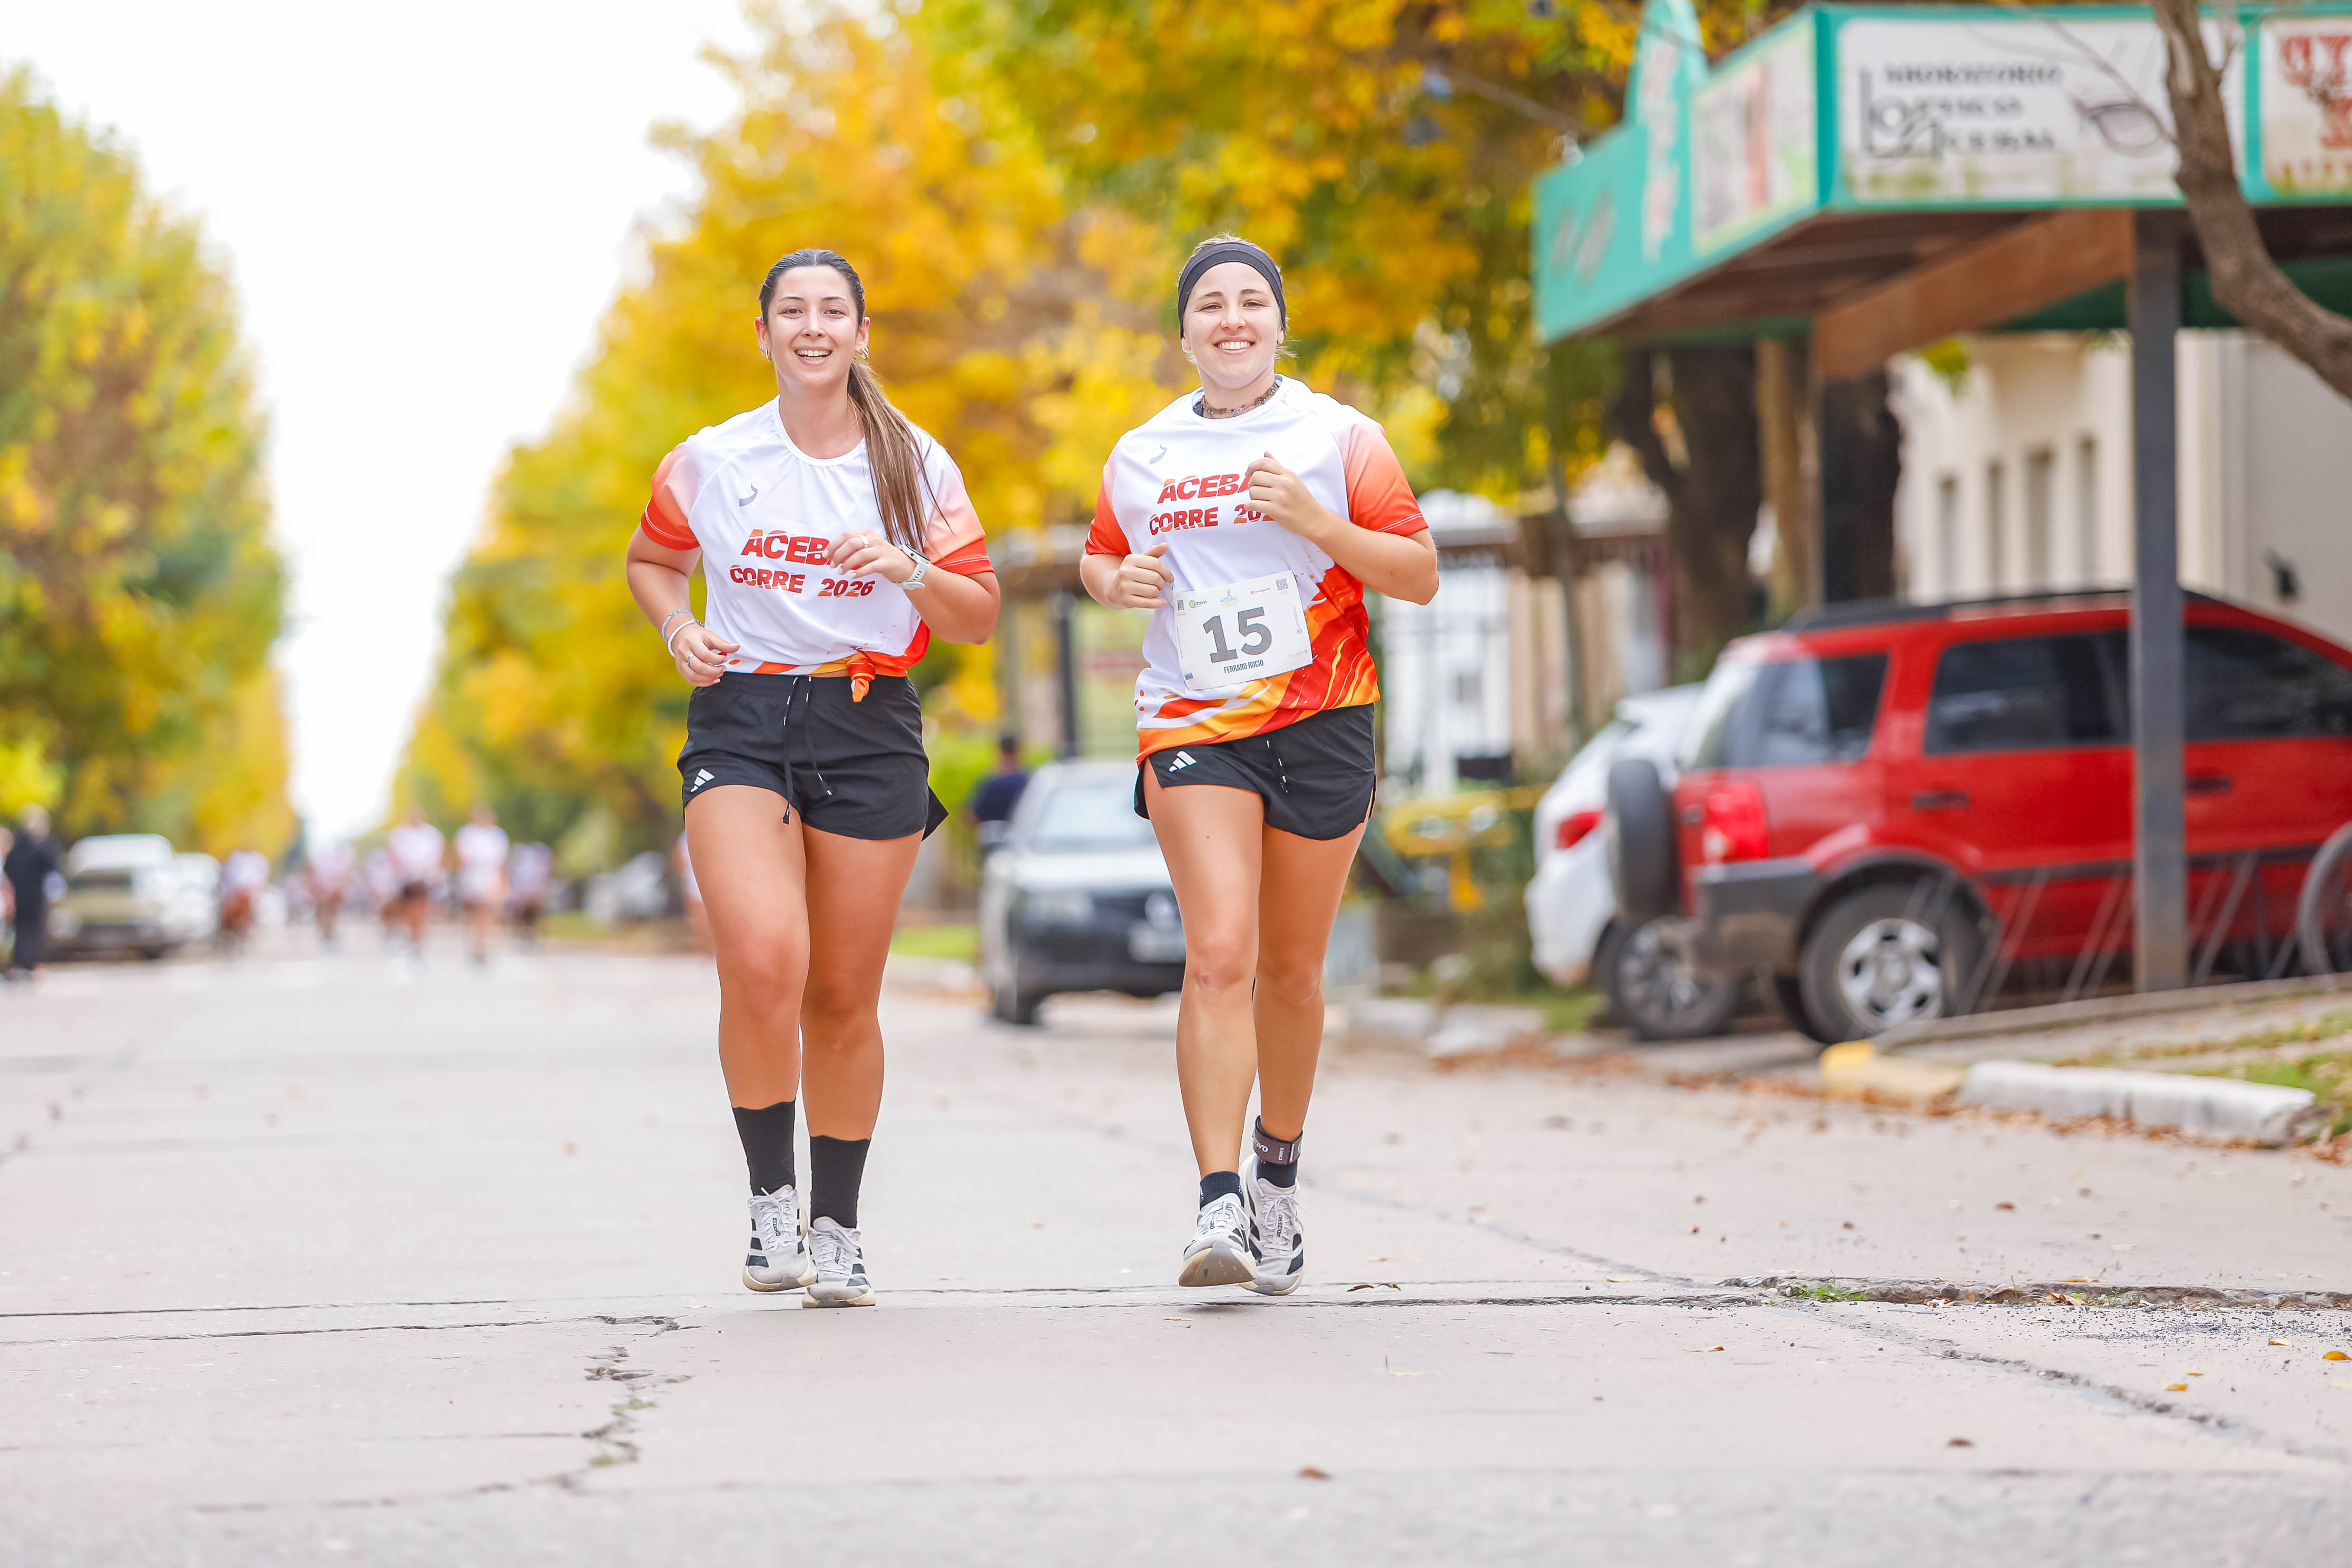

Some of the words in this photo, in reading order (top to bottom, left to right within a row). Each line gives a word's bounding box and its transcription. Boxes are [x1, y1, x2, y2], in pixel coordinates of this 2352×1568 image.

[1157, 474, 1252, 504] ACEBA
[1149, 507, 1218, 535] CORRE
[1233, 504, 1276, 524] 20
[741, 529, 864, 571] ACEB
[730, 564, 806, 593] CORRE
[818, 579, 876, 597] 2026
[1203, 606, 1272, 663] 15
[1223, 663, 1247, 674] FERRARO
[1248, 659, 1264, 669] ROCIO
